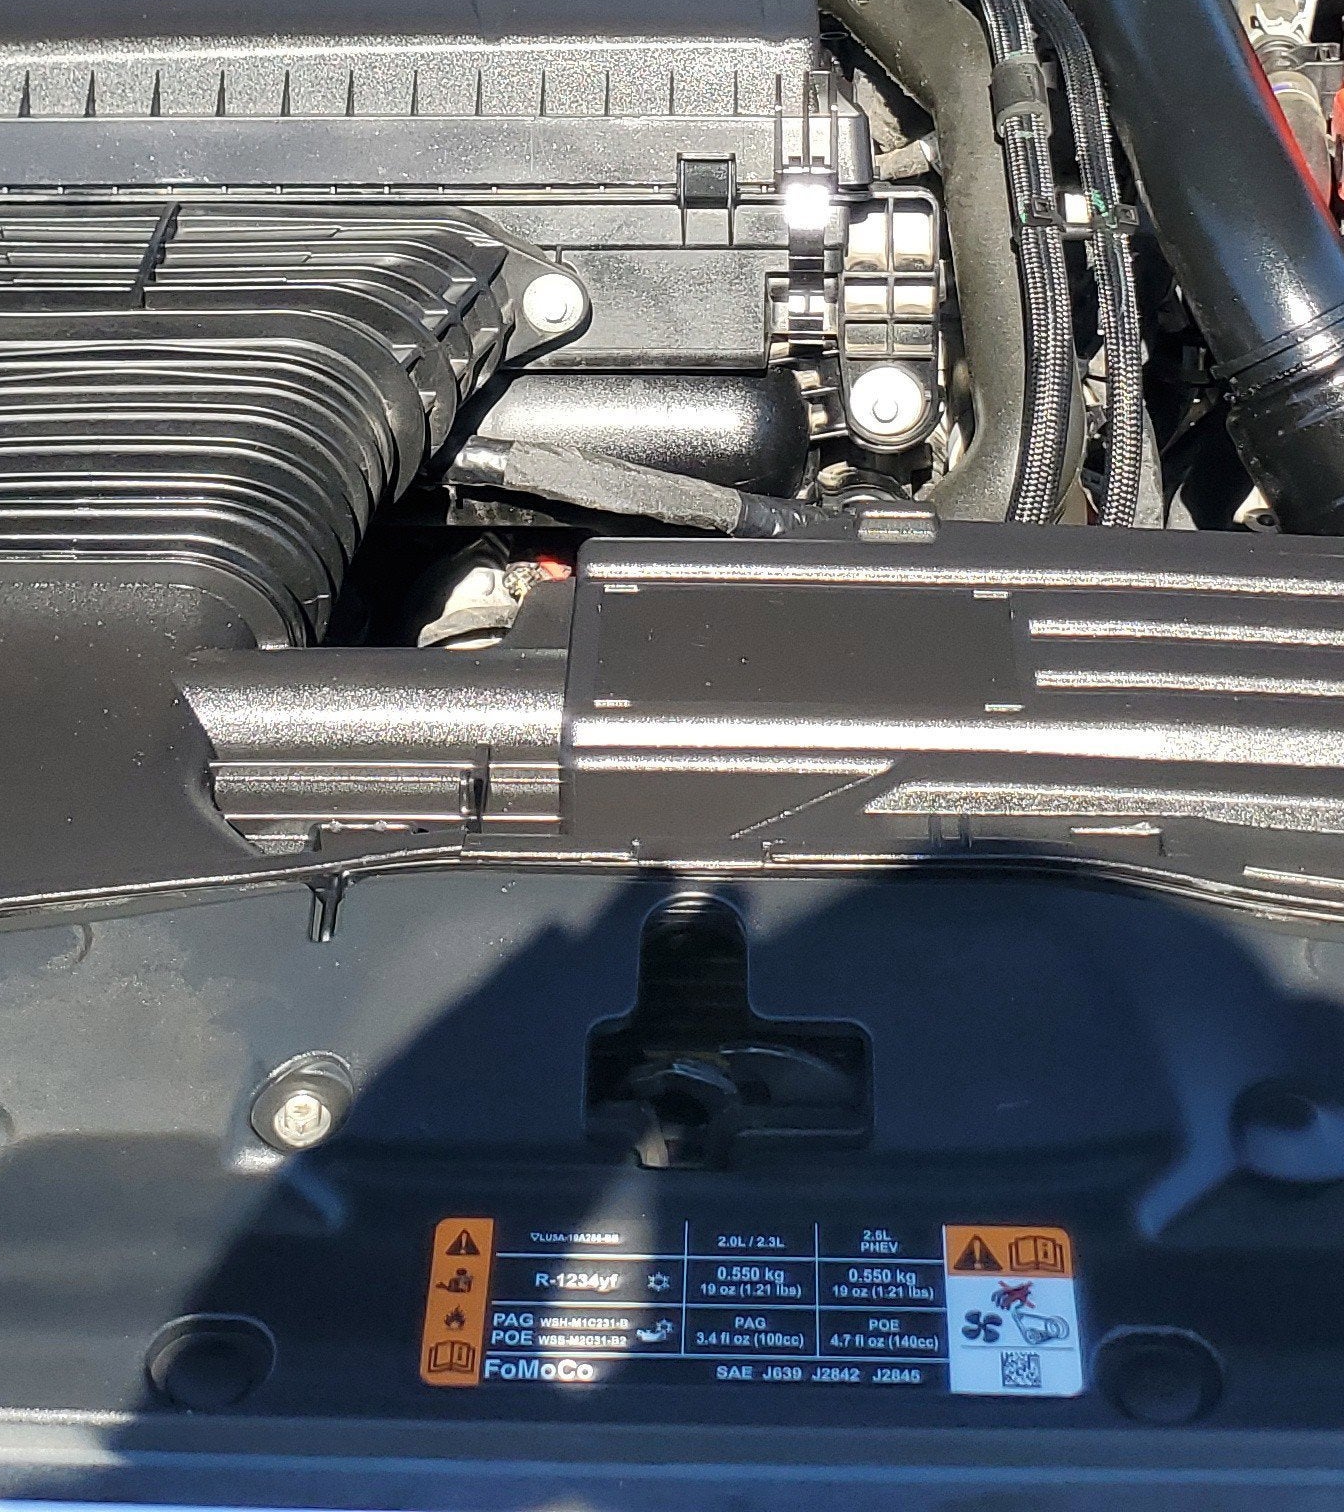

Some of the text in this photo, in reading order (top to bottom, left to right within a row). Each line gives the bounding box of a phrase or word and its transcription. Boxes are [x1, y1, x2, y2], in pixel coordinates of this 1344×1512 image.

[717, 1236, 747, 1248] 2.0L
[756, 1236, 785, 1249] 2.3L
[860, 1241, 899, 1254] PHEV
[535, 1273, 619, 1292] R-1234yf
[717, 1266, 785, 1284] 0.550 kg
[848, 1268, 917, 1286] 0.550 kg
[700, 1283, 802, 1298] 19 oz (1.21 lbs)
[831, 1285, 934, 1300] 19 oz (1.21 lbs)
[493, 1313, 534, 1328] PAG
[735, 1316, 767, 1329] PAG
[869, 1318, 899, 1332] POE
[491, 1330, 534, 1346] POE
[695, 1332, 718, 1345] 3.4
[733, 1335, 750, 1345] oz
[753, 1333, 804, 1348] (100cc)
[829, 1334, 851, 1347] 4.7
[867, 1337, 885, 1348] oz
[888, 1335, 939, 1351] (140cc)
[484, 1358, 594, 1381] FoMoCo
[716, 1365, 753, 1379] SAE
[761, 1366, 803, 1381] J639
